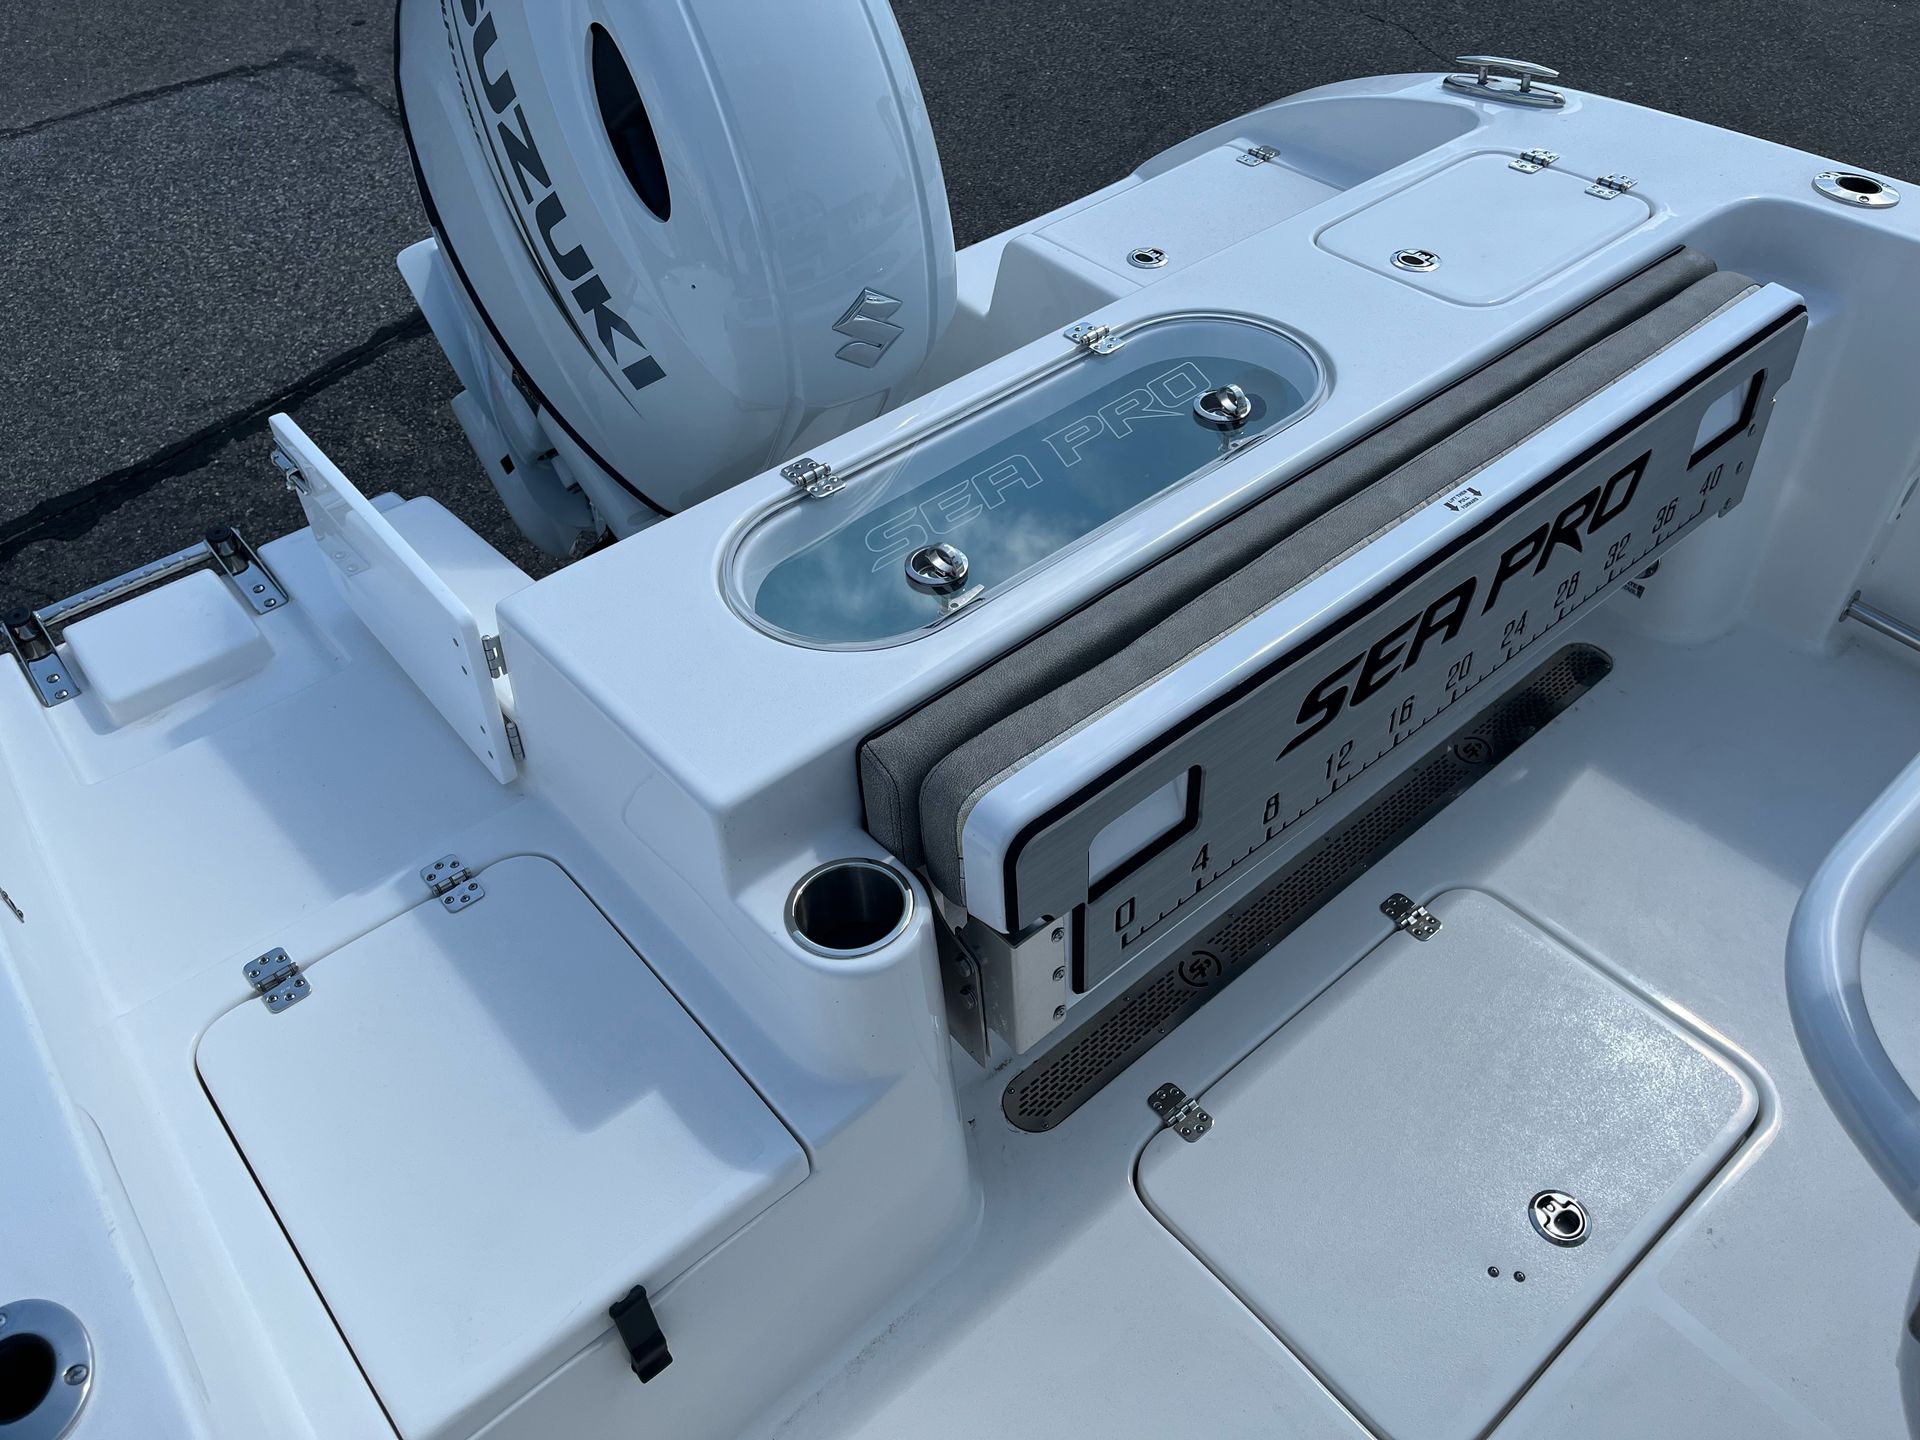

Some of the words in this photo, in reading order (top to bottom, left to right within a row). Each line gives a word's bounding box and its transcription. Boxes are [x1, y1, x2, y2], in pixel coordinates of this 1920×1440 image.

[865, 454, 1040, 573] SEA
[1042, 361, 1212, 468] PRO
[1276, 576, 1477, 762] SEA
[1481, 449, 1652, 616] PRO
[1115, 895, 1136, 934] 0
[1191, 843, 1211, 873] 4
[1263, 793, 1281, 826] 8
[1325, 739, 1354, 780] 12
[1387, 694, 1415, 735] 16
[1445, 651, 1473, 692] 20
[1501, 610, 1528, 649] 24
[1553, 570, 1581, 609] 28
[1603, 532, 1633, 570] 32
[1652, 497, 1680, 533] 36
[1700, 464, 1725, 496] 40
